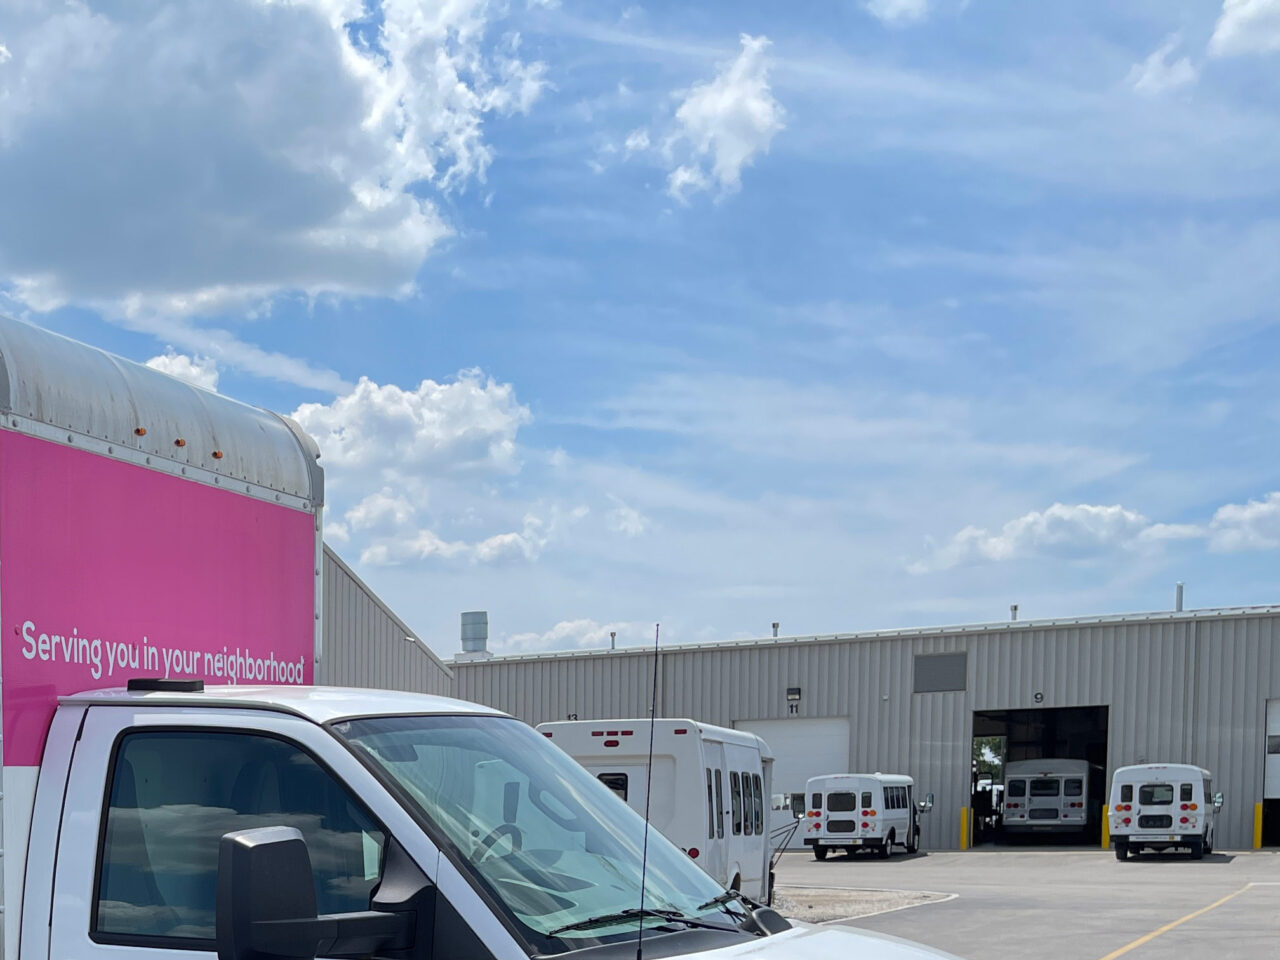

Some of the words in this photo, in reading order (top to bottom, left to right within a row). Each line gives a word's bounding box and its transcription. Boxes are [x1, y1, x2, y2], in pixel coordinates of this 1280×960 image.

[22, 620, 102, 680] Serving
[105, 641, 140, 677] you
[143, 636, 159, 670] in
[162, 647, 201, 679] your
[204, 646, 304, 685] neighborhood
[1034, 692, 1044, 703] 9
[789, 703, 798, 714] 11
